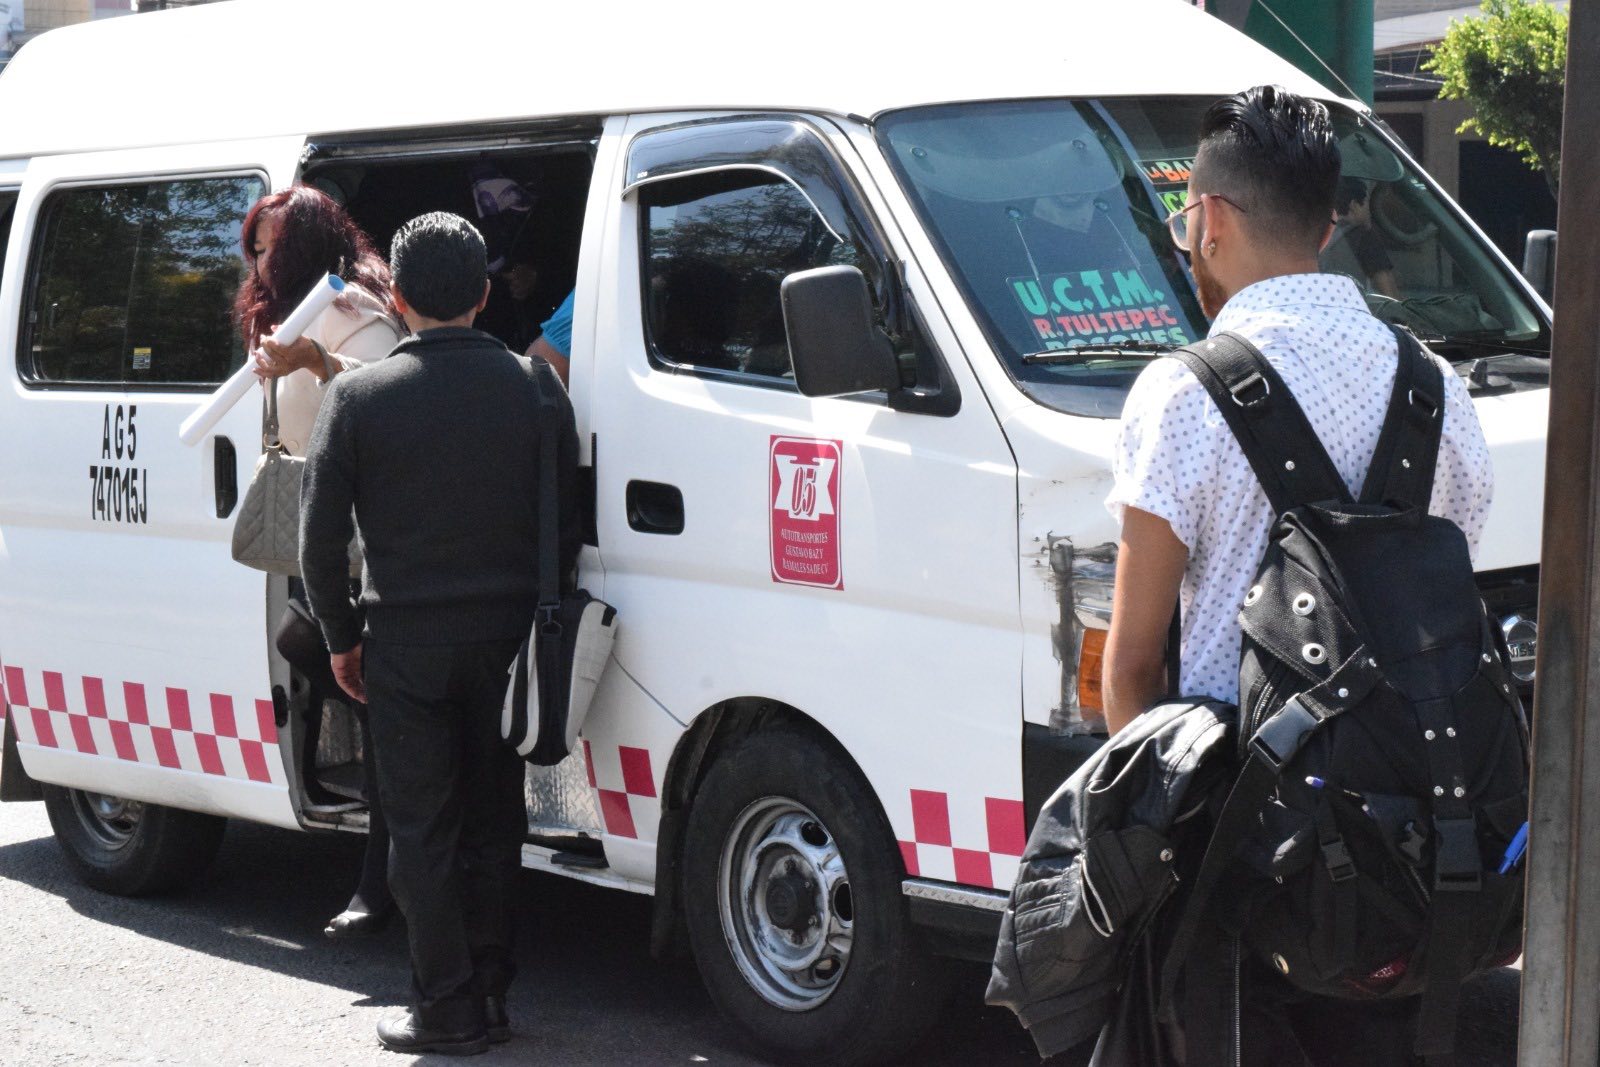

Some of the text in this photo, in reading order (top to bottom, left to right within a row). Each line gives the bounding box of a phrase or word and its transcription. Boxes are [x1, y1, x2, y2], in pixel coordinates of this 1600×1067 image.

[1155, 160, 1194, 181] BA
[1013, 269, 1165, 316] U.C.T.M.
[89, 465, 147, 524] 747015J
[791, 466, 816, 517] 05
[781, 528, 828, 544] AUTOTRANSPORTES
